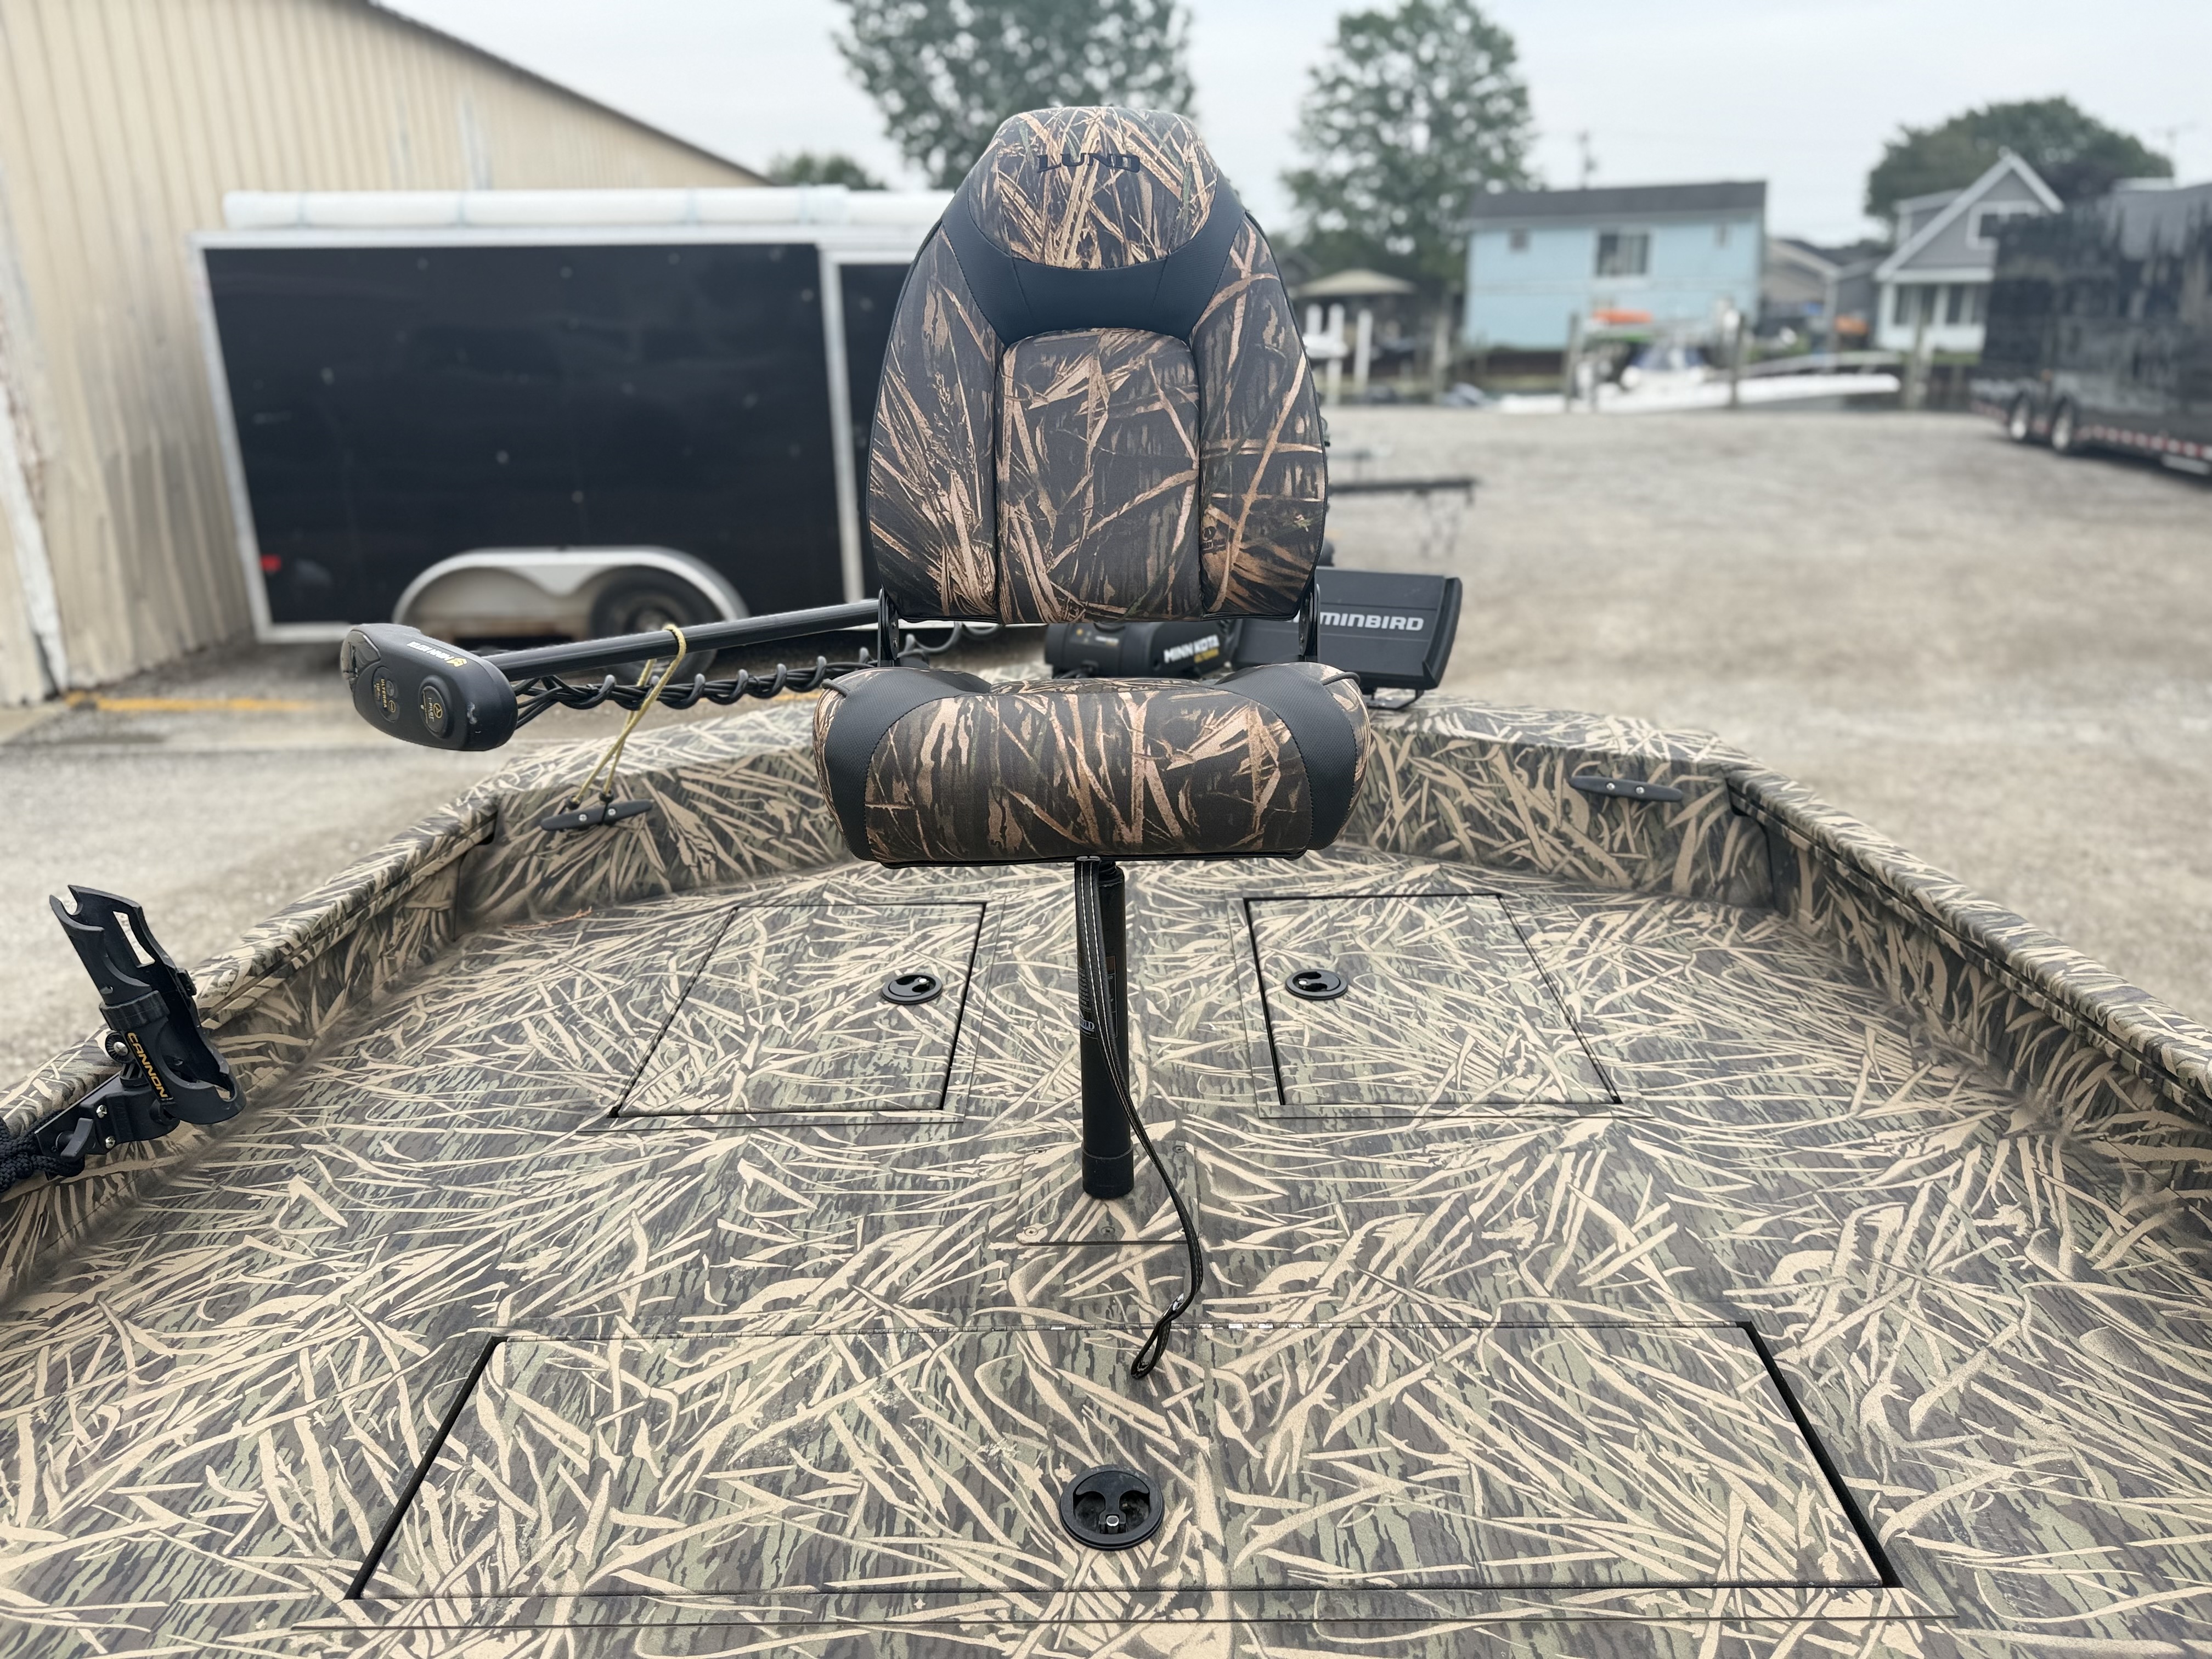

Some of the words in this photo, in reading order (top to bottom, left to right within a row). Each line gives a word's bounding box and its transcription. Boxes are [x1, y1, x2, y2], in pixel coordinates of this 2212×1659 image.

[1037, 153, 1140, 173] LUND
[1286, 611, 1424, 631] MINBIRD
[127, 1032, 168, 1097] CANNON
